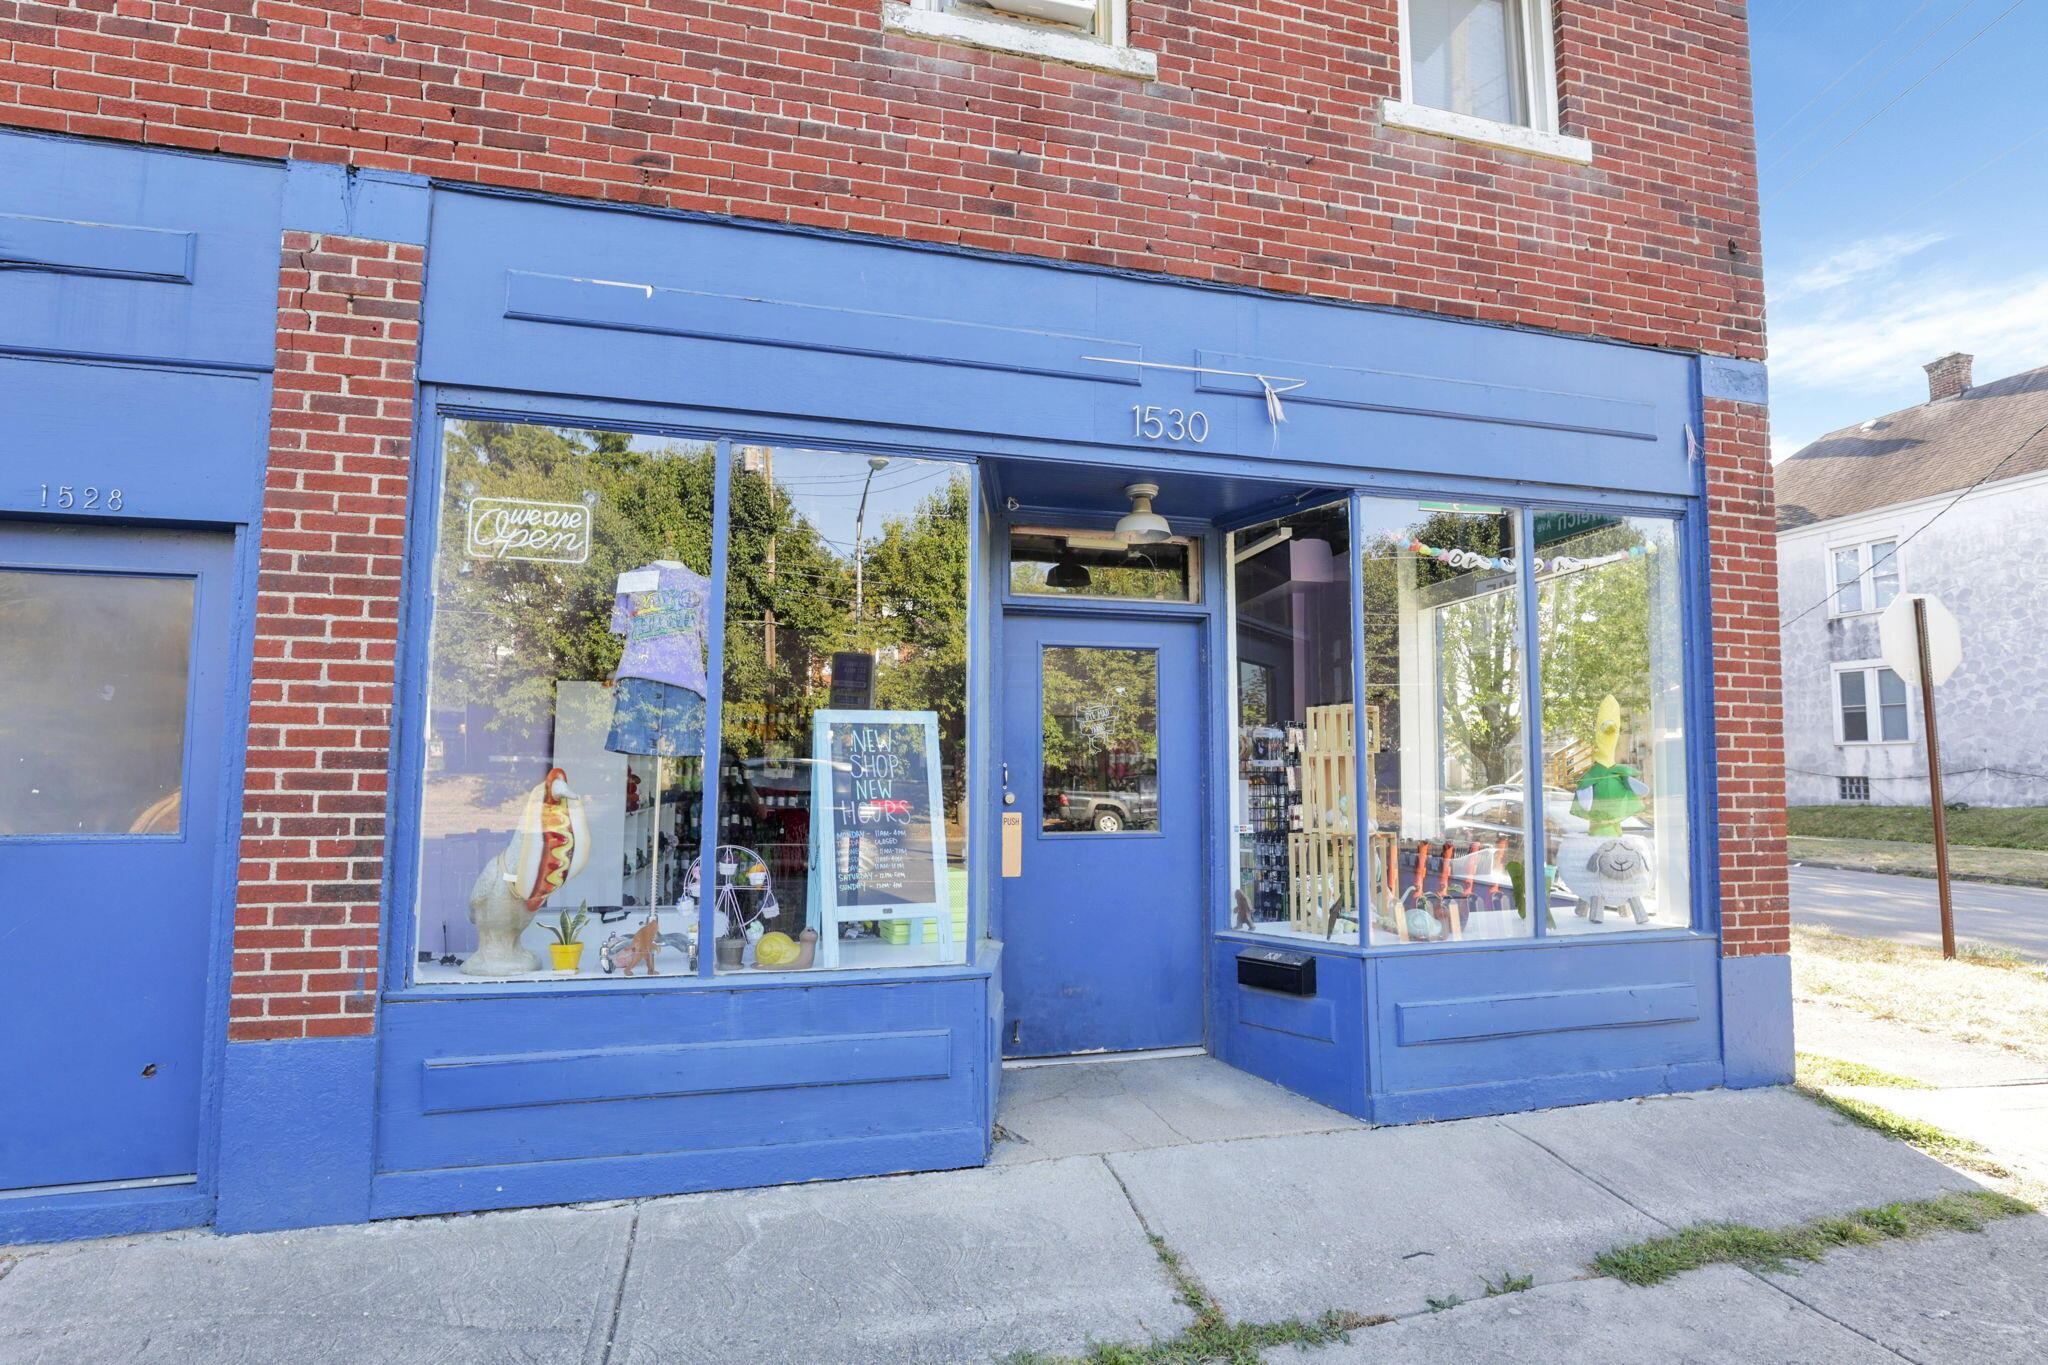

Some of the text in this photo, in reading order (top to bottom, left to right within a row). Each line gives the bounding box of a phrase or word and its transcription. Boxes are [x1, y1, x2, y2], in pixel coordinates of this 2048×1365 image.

[1132, 404, 1209, 443] 1530
[41, 484, 123, 511] 1528
[510, 508, 582, 529] we are
[474, 508, 584, 558] Open
[852, 729, 891, 752] NEW
[849, 754, 899, 778] SHOP
[856, 779, 892, 800] NEW
[841, 799, 911, 825] HOURS
[1003, 817, 1020, 826] PUSH
[838, 872, 873, 881] SATURDAY
[839, 881, 866, 892] SUNDAY
